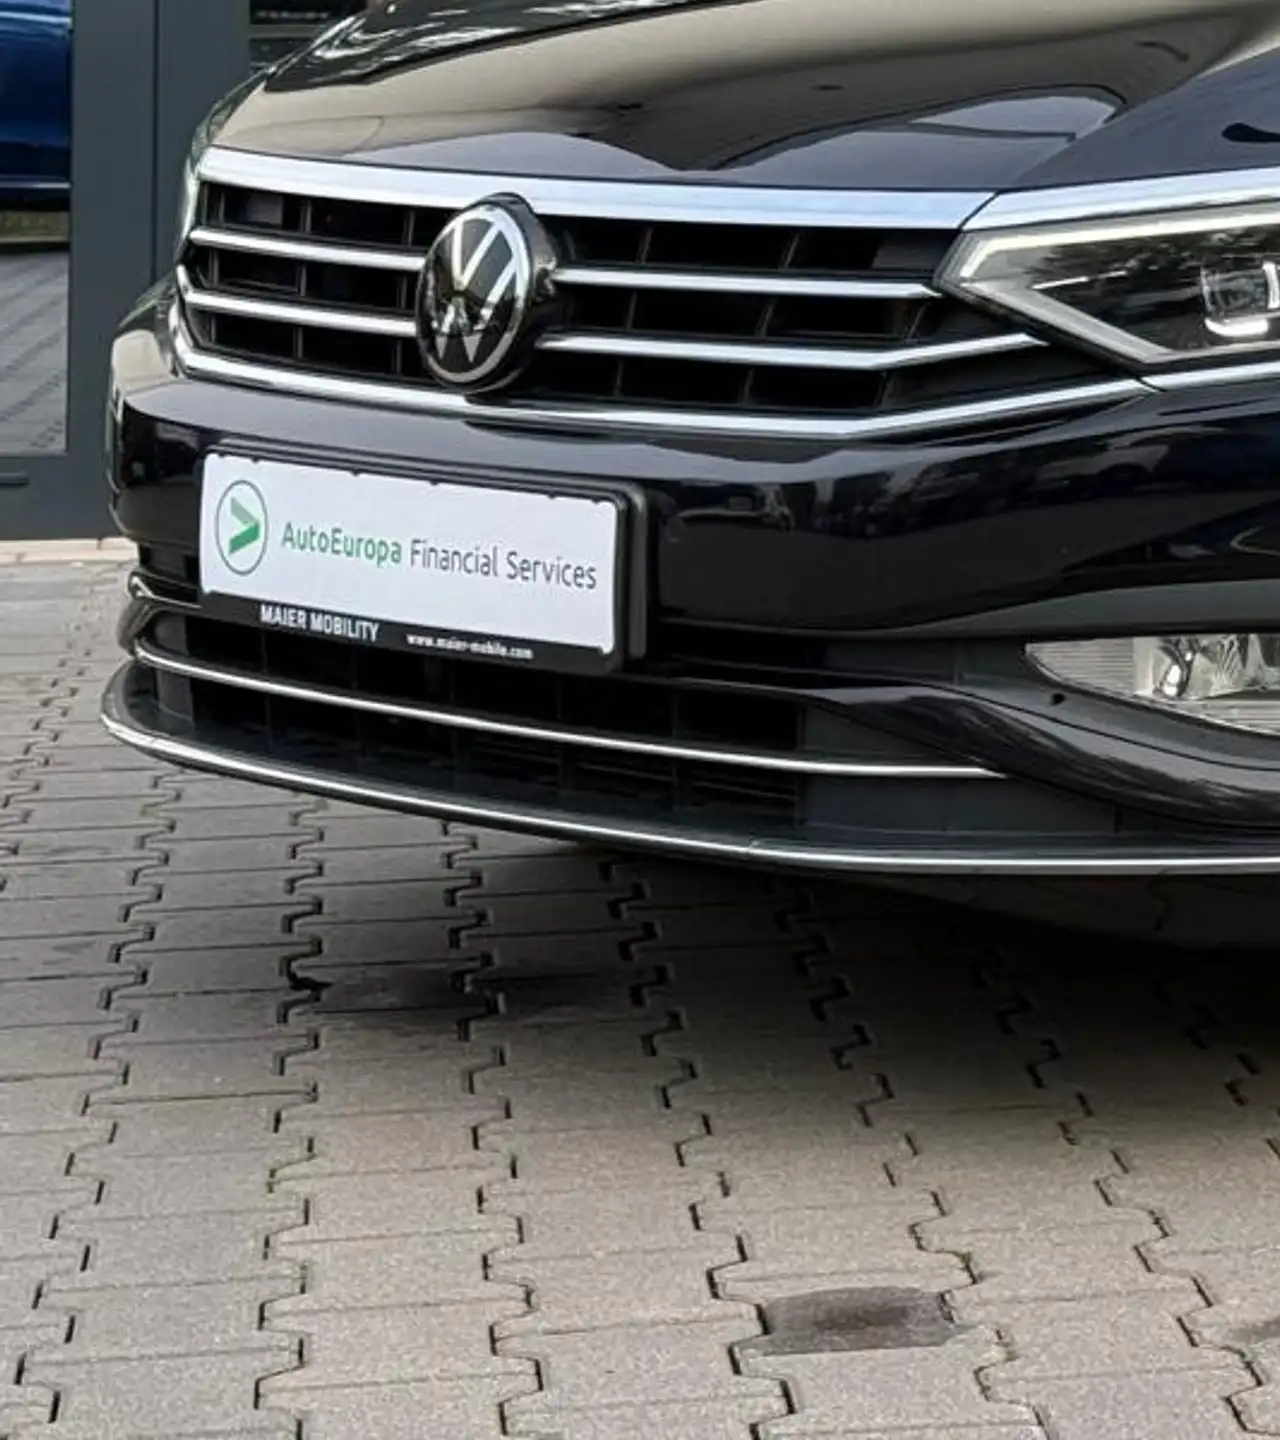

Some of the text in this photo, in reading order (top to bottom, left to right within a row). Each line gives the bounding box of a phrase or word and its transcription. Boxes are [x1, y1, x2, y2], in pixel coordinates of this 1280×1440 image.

[281, 521, 597, 590] AutoEuropa Financial Services
[260, 603, 381, 643] MAIER MOBILITY
[405, 632, 534, 660] www.maier-mobile.com
